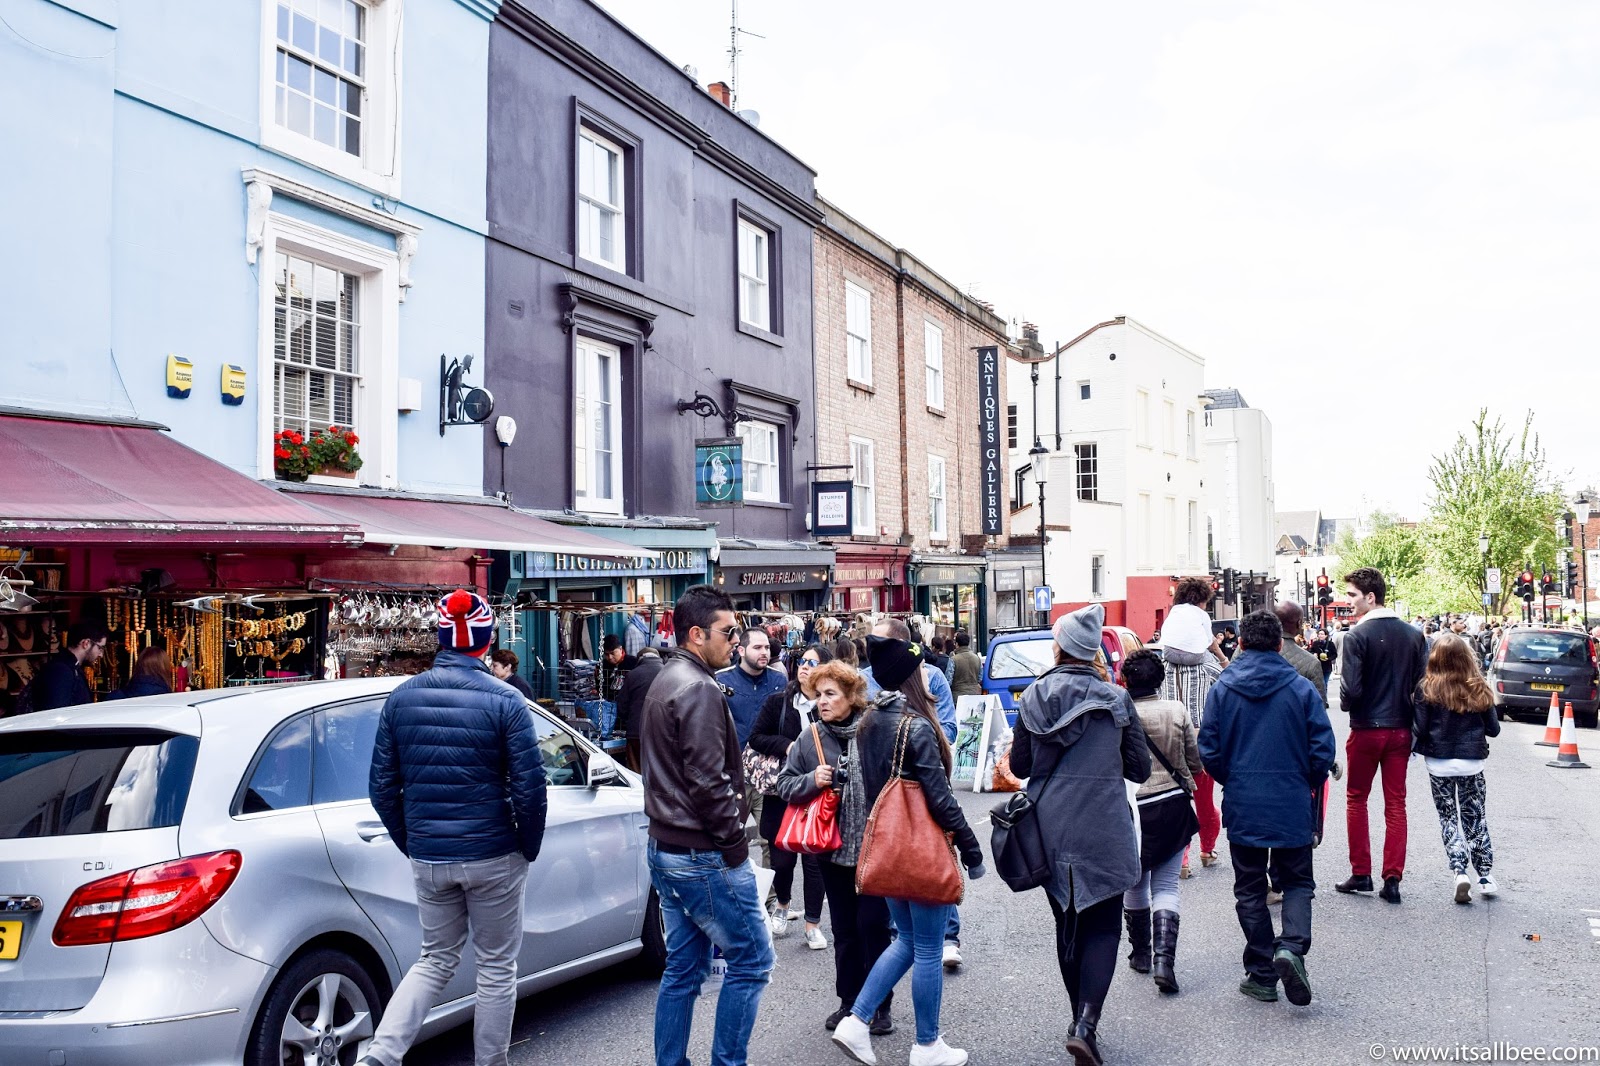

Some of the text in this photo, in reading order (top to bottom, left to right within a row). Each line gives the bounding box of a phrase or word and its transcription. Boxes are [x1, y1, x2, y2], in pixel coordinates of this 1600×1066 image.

[984, 351, 997, 530] ANTIQUES GALLERY
[650, 551, 693, 569] STORE
[742, 572, 775, 585] STUMPER
[778, 571, 806, 583] FIELDING
[83, 861, 113, 871] CDI
